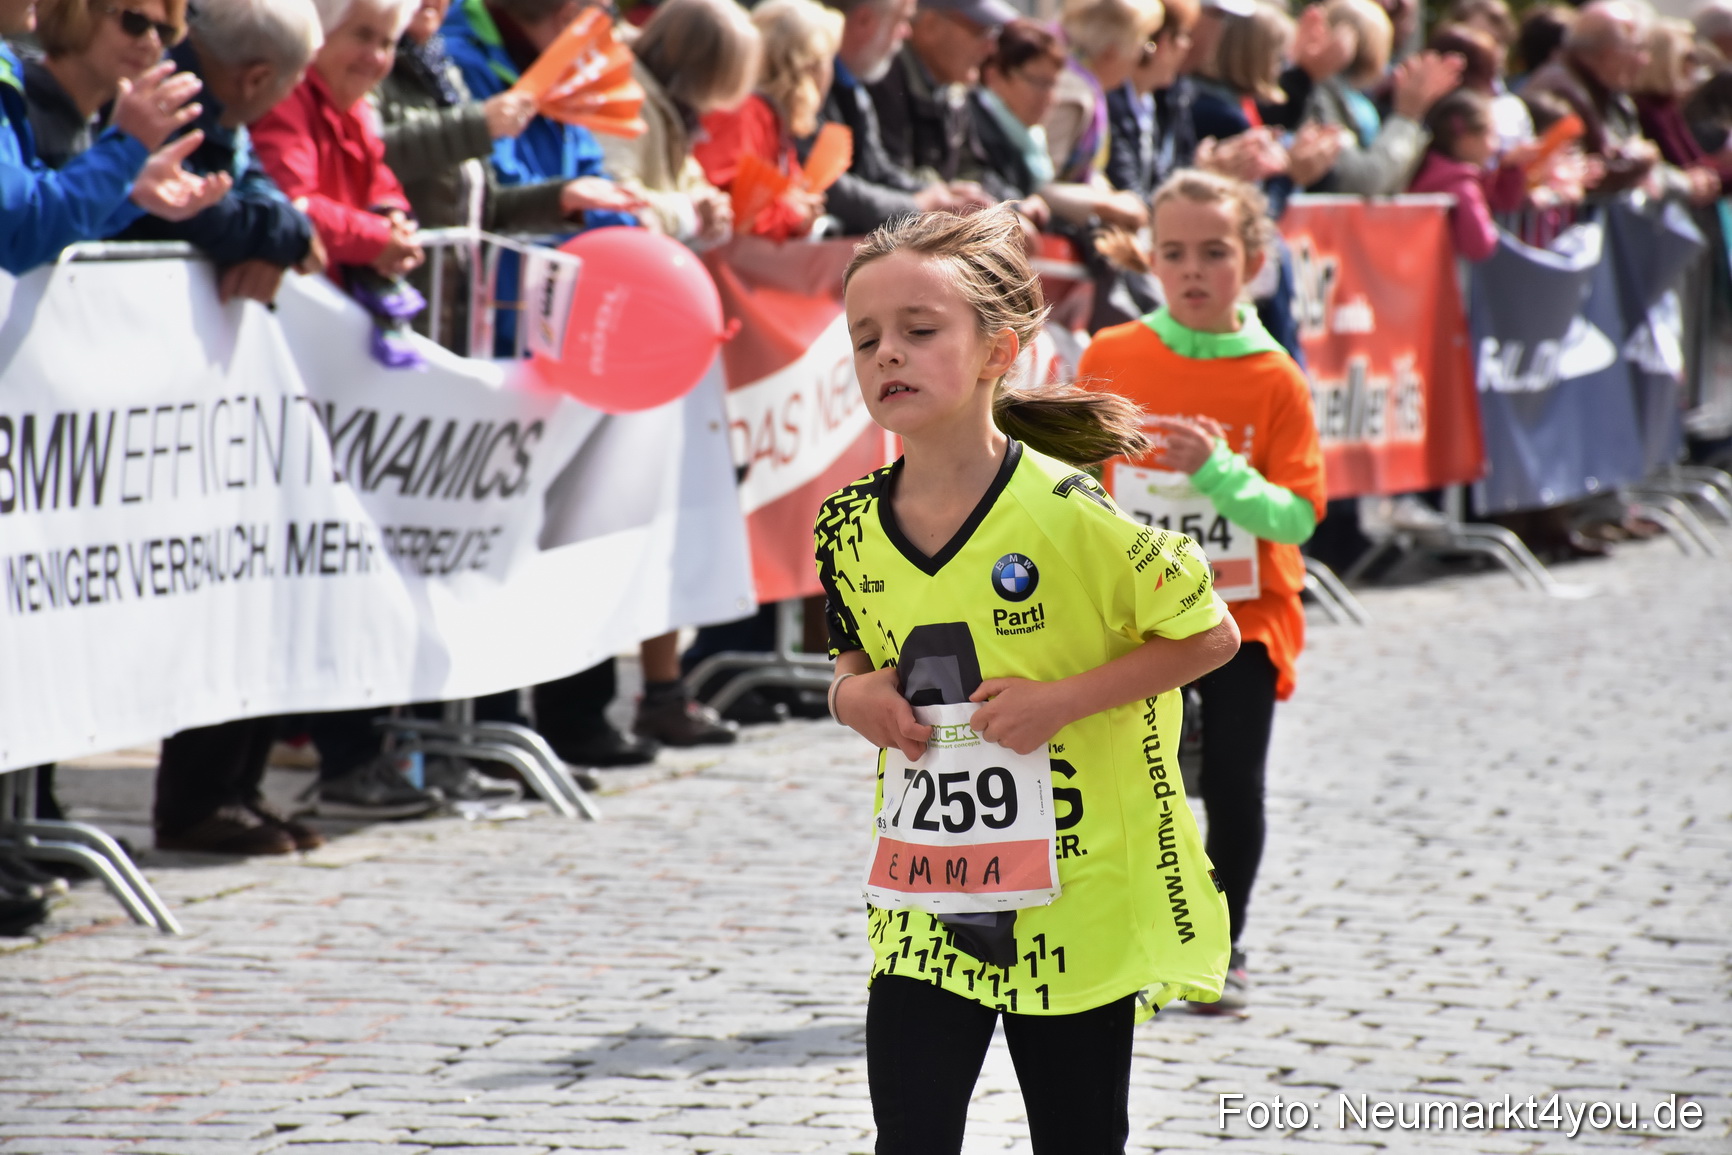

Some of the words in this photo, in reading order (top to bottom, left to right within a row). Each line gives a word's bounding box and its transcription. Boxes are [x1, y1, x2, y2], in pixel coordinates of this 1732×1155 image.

[0, 409, 115, 514] BMW
[5, 545, 122, 614] WENIGER
[995, 554, 1034, 571] BMW
[993, 602, 1045, 627] Partl
[995, 621, 1045, 636] Neumarkt
[890, 766, 1019, 834] 7259
[1142, 693, 1197, 945] www.bmw-partl.de
[889, 853, 1000, 886] EMMA
